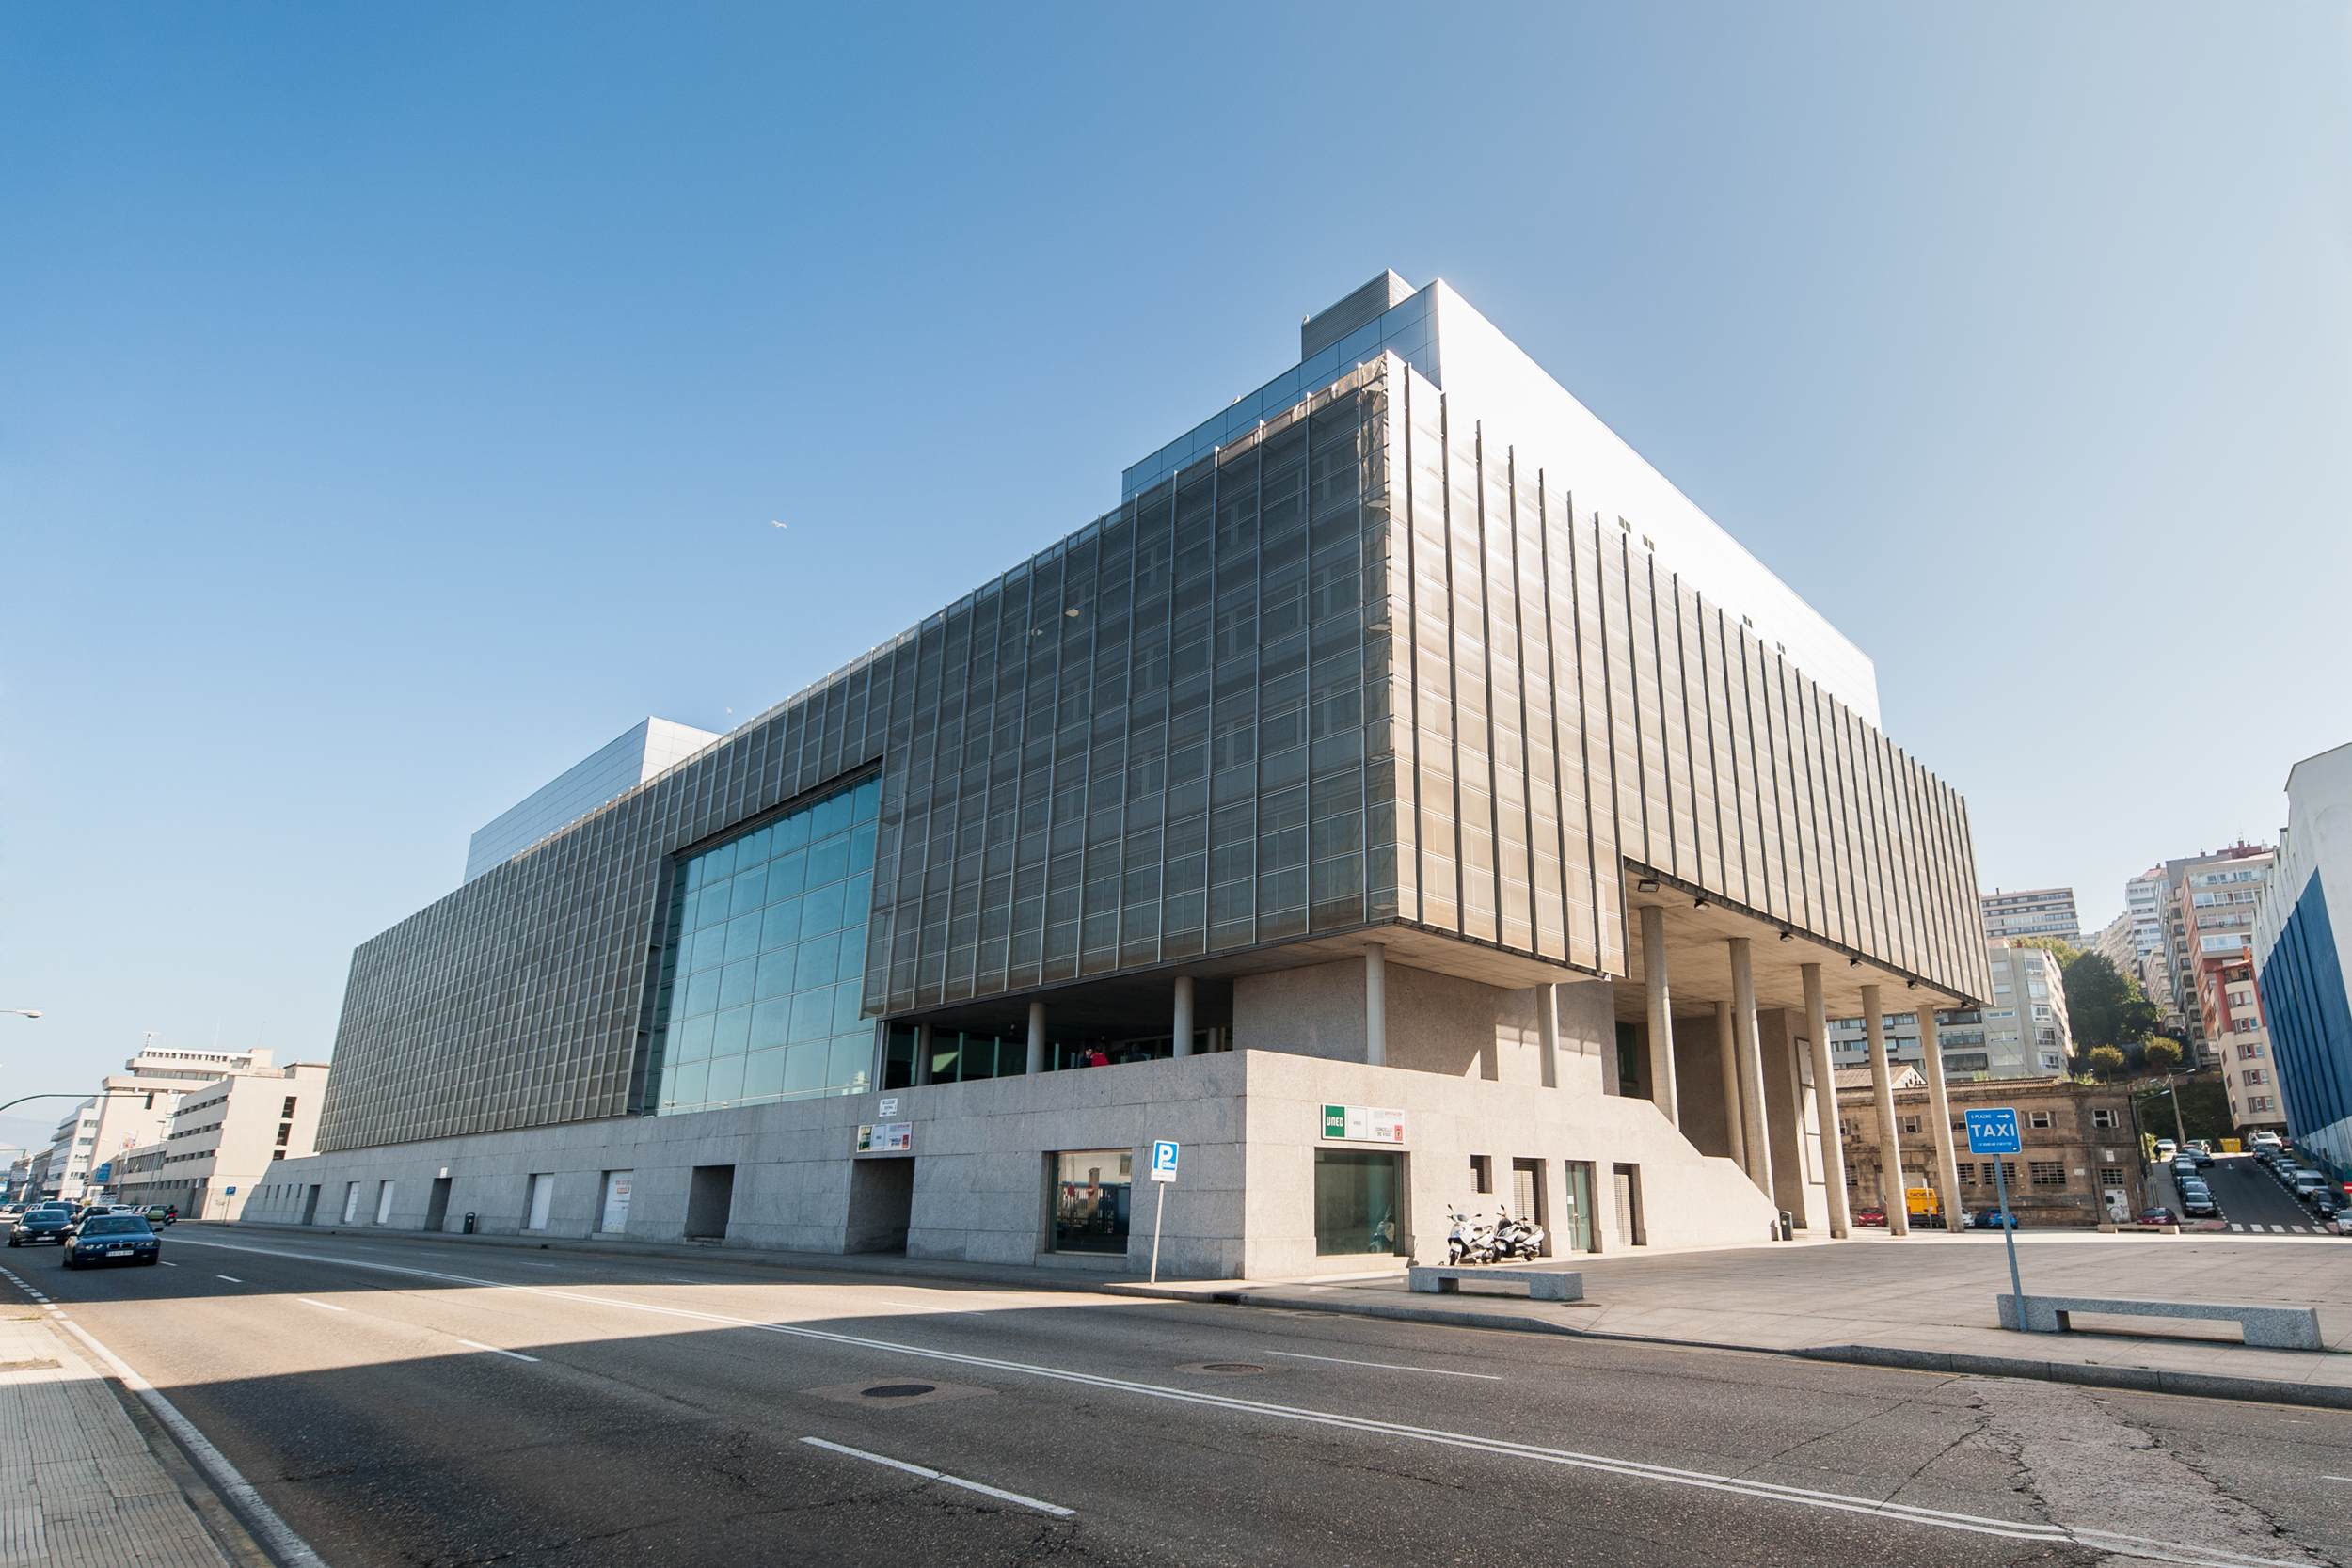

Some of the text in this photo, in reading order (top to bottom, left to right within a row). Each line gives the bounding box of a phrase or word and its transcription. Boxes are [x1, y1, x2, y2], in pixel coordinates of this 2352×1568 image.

[1326, 1116, 1343, 1127] UNED
[1970, 1123, 2015, 1137] TAXI
[1158, 1144, 1173, 1169] P
